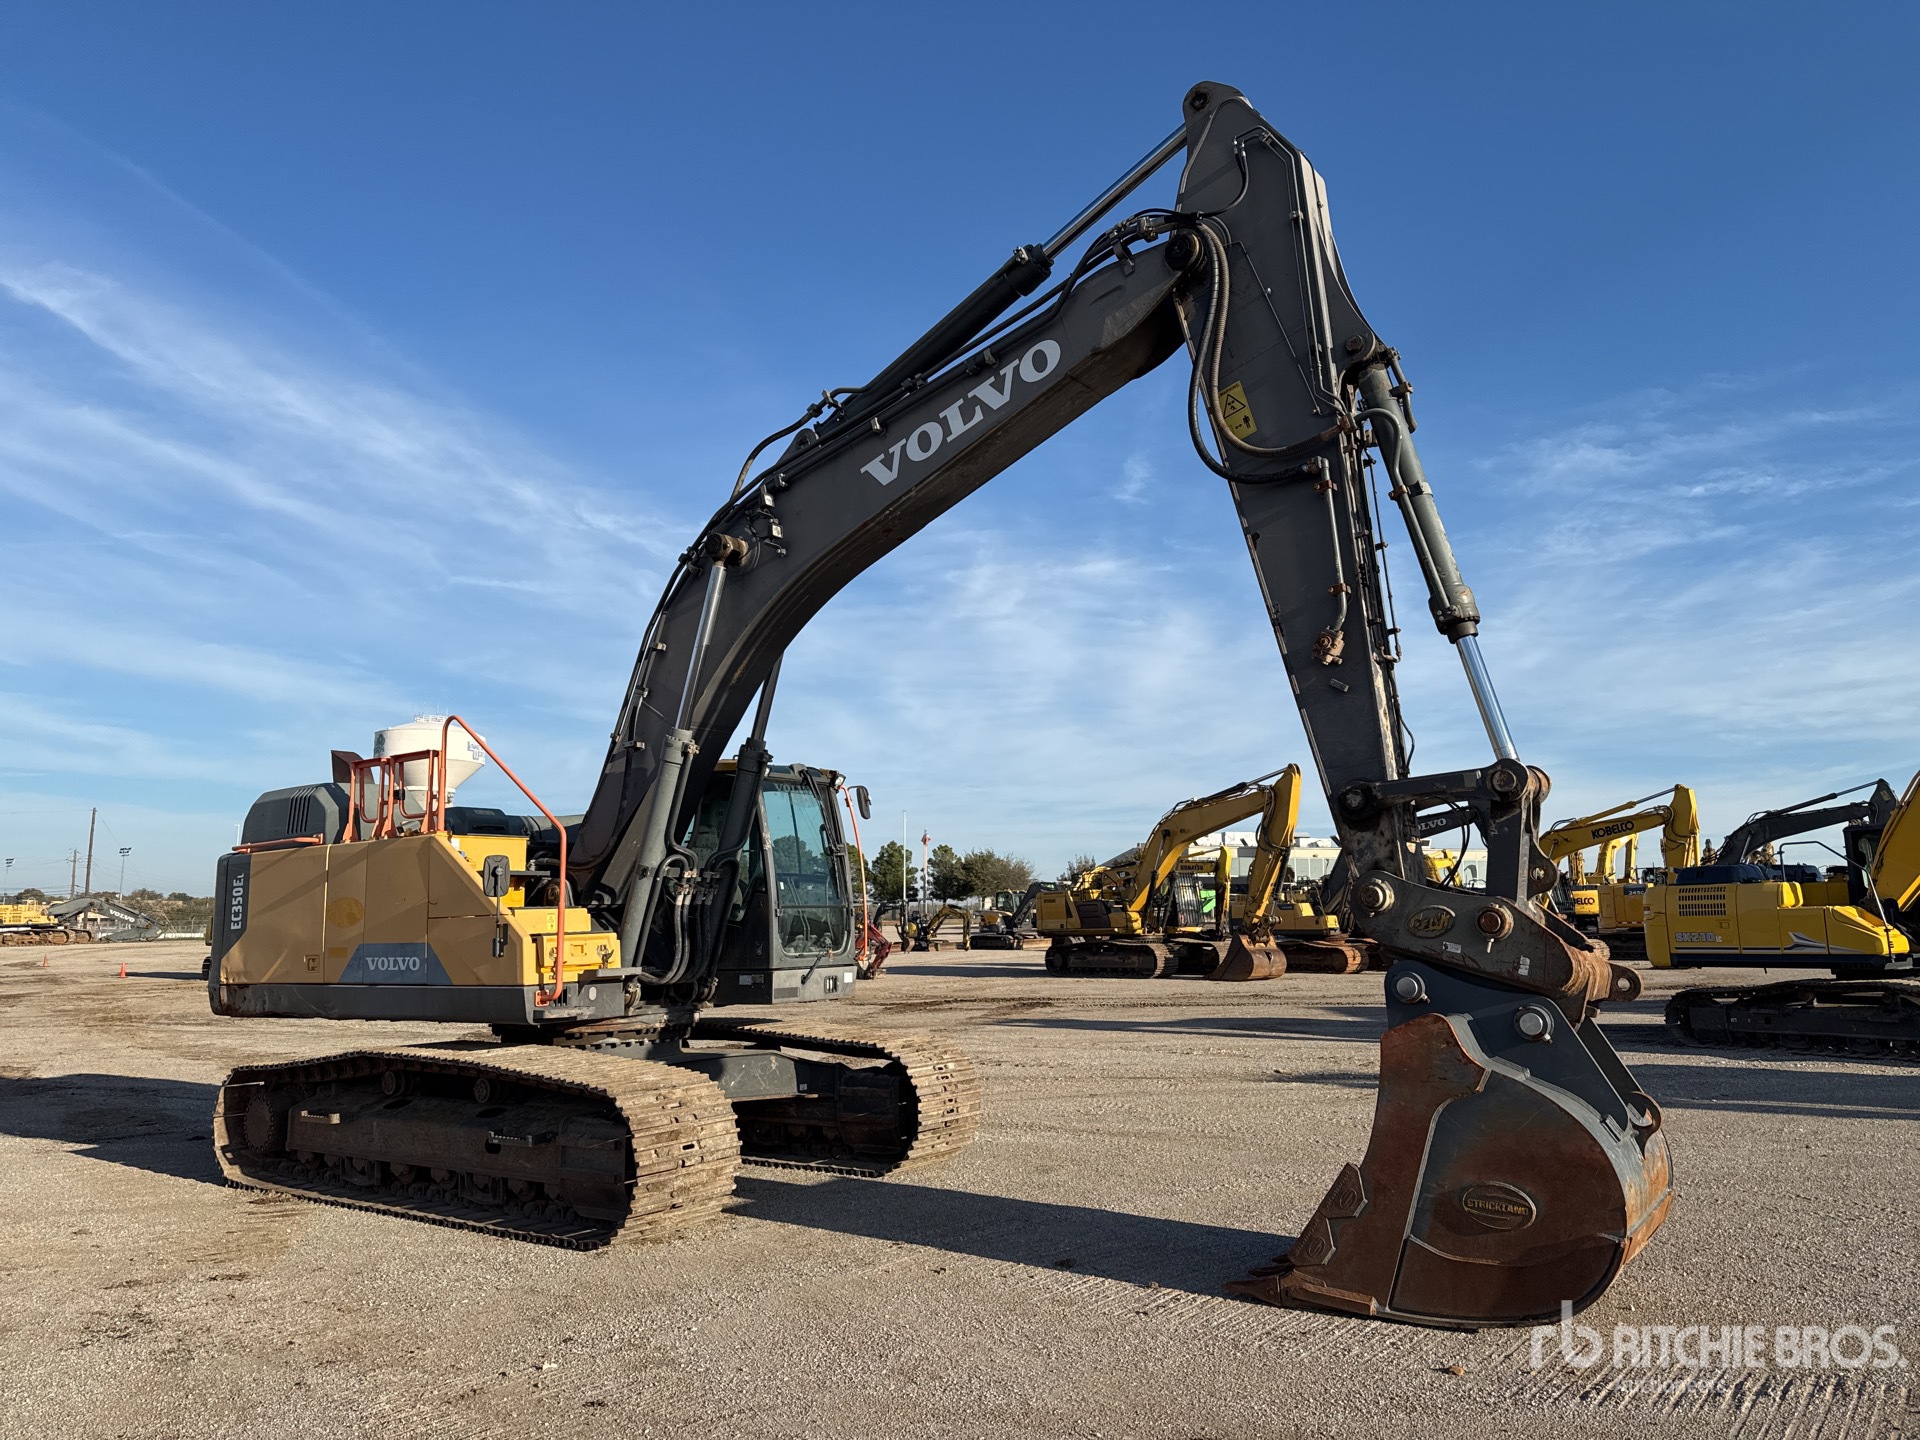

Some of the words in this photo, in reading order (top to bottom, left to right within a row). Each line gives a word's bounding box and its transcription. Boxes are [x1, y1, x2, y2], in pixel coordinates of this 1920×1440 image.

[860, 339, 1061, 487] VOLVO
[1418, 818, 1447, 831] LVO
[1591, 820, 1635, 840] KOBELCO
[109, 909, 135, 922] VOLVO
[365, 956, 420, 971] VOLVO
[1467, 1199, 1529, 1216] STRICKLAND
